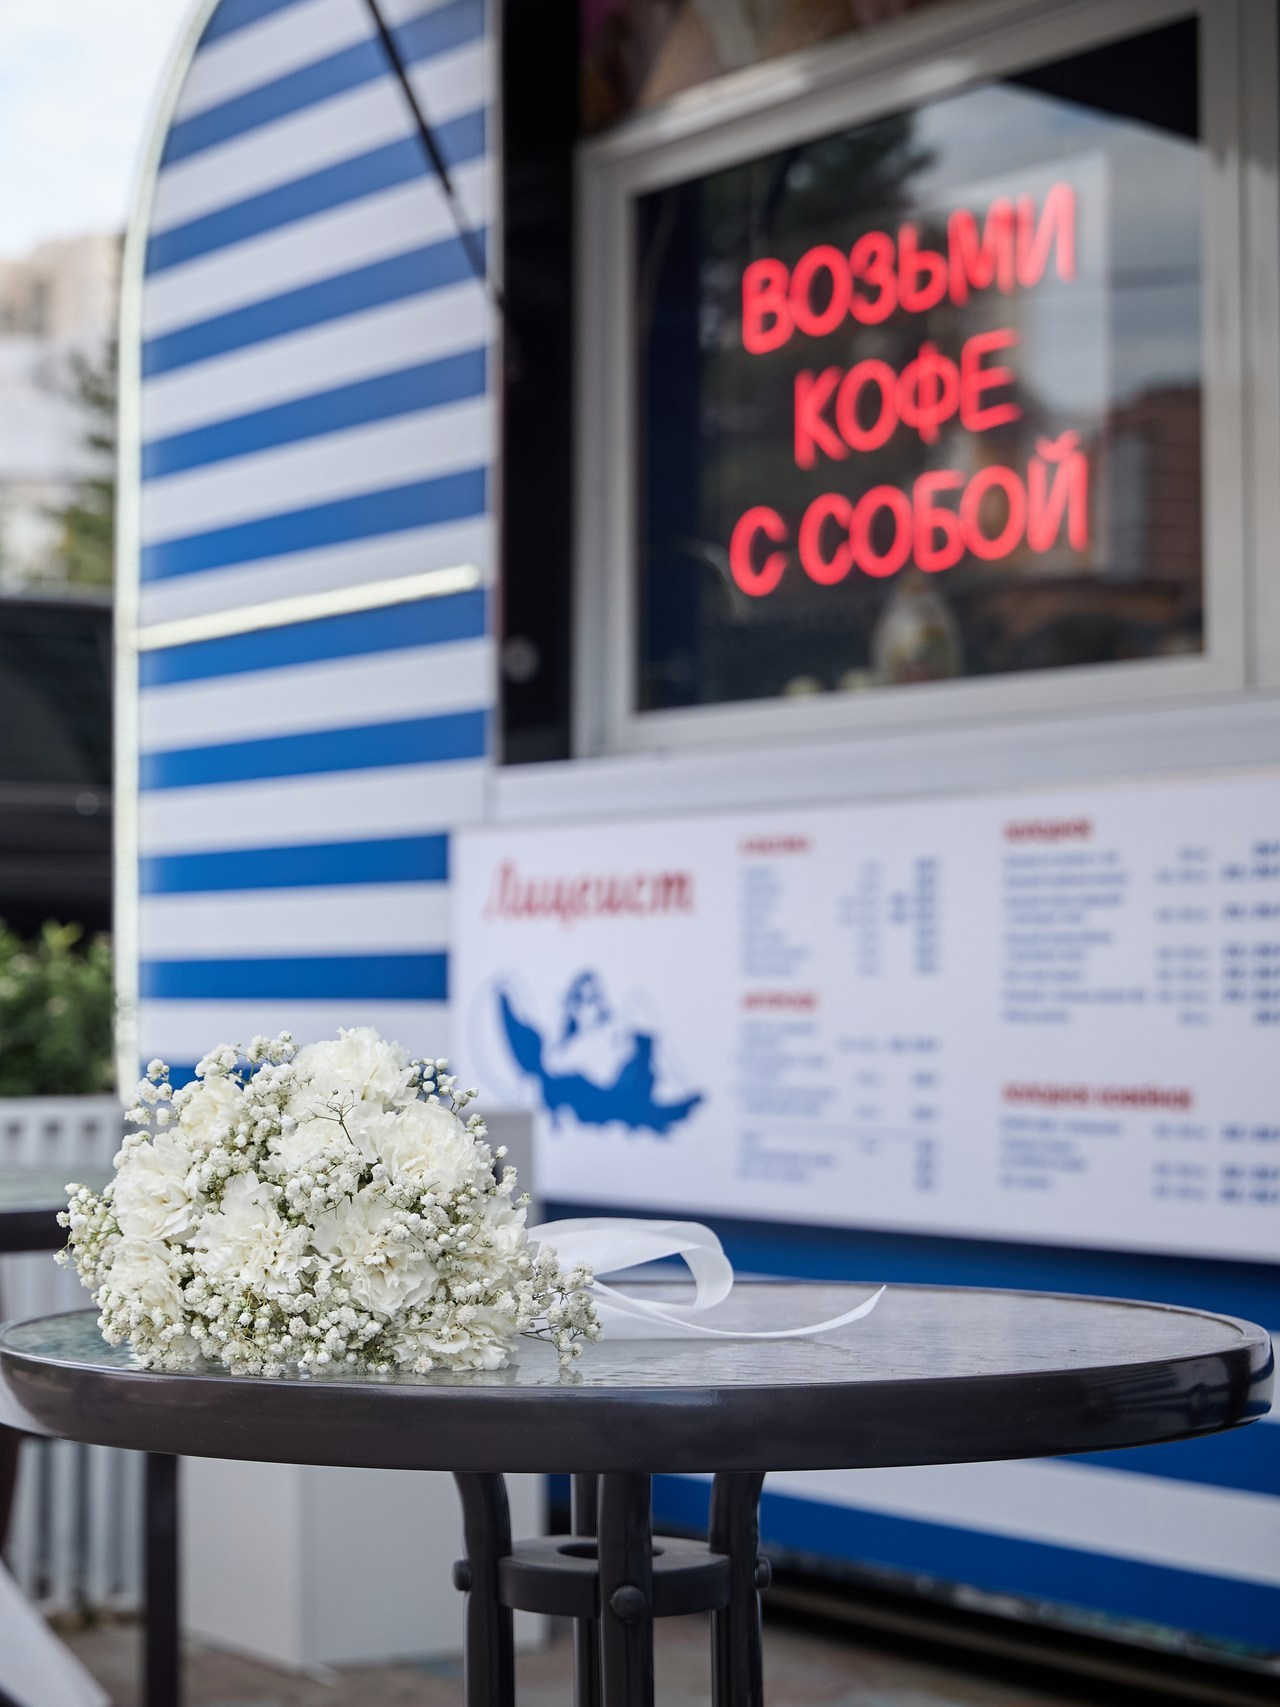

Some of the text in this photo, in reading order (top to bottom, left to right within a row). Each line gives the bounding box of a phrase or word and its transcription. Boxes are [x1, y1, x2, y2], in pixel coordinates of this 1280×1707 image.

[741, 182, 1076, 356] ВОЗЬМИ
[793, 327, 1021, 471] КОФЕ
[729, 430, 1089, 597] С СОБОЙ
